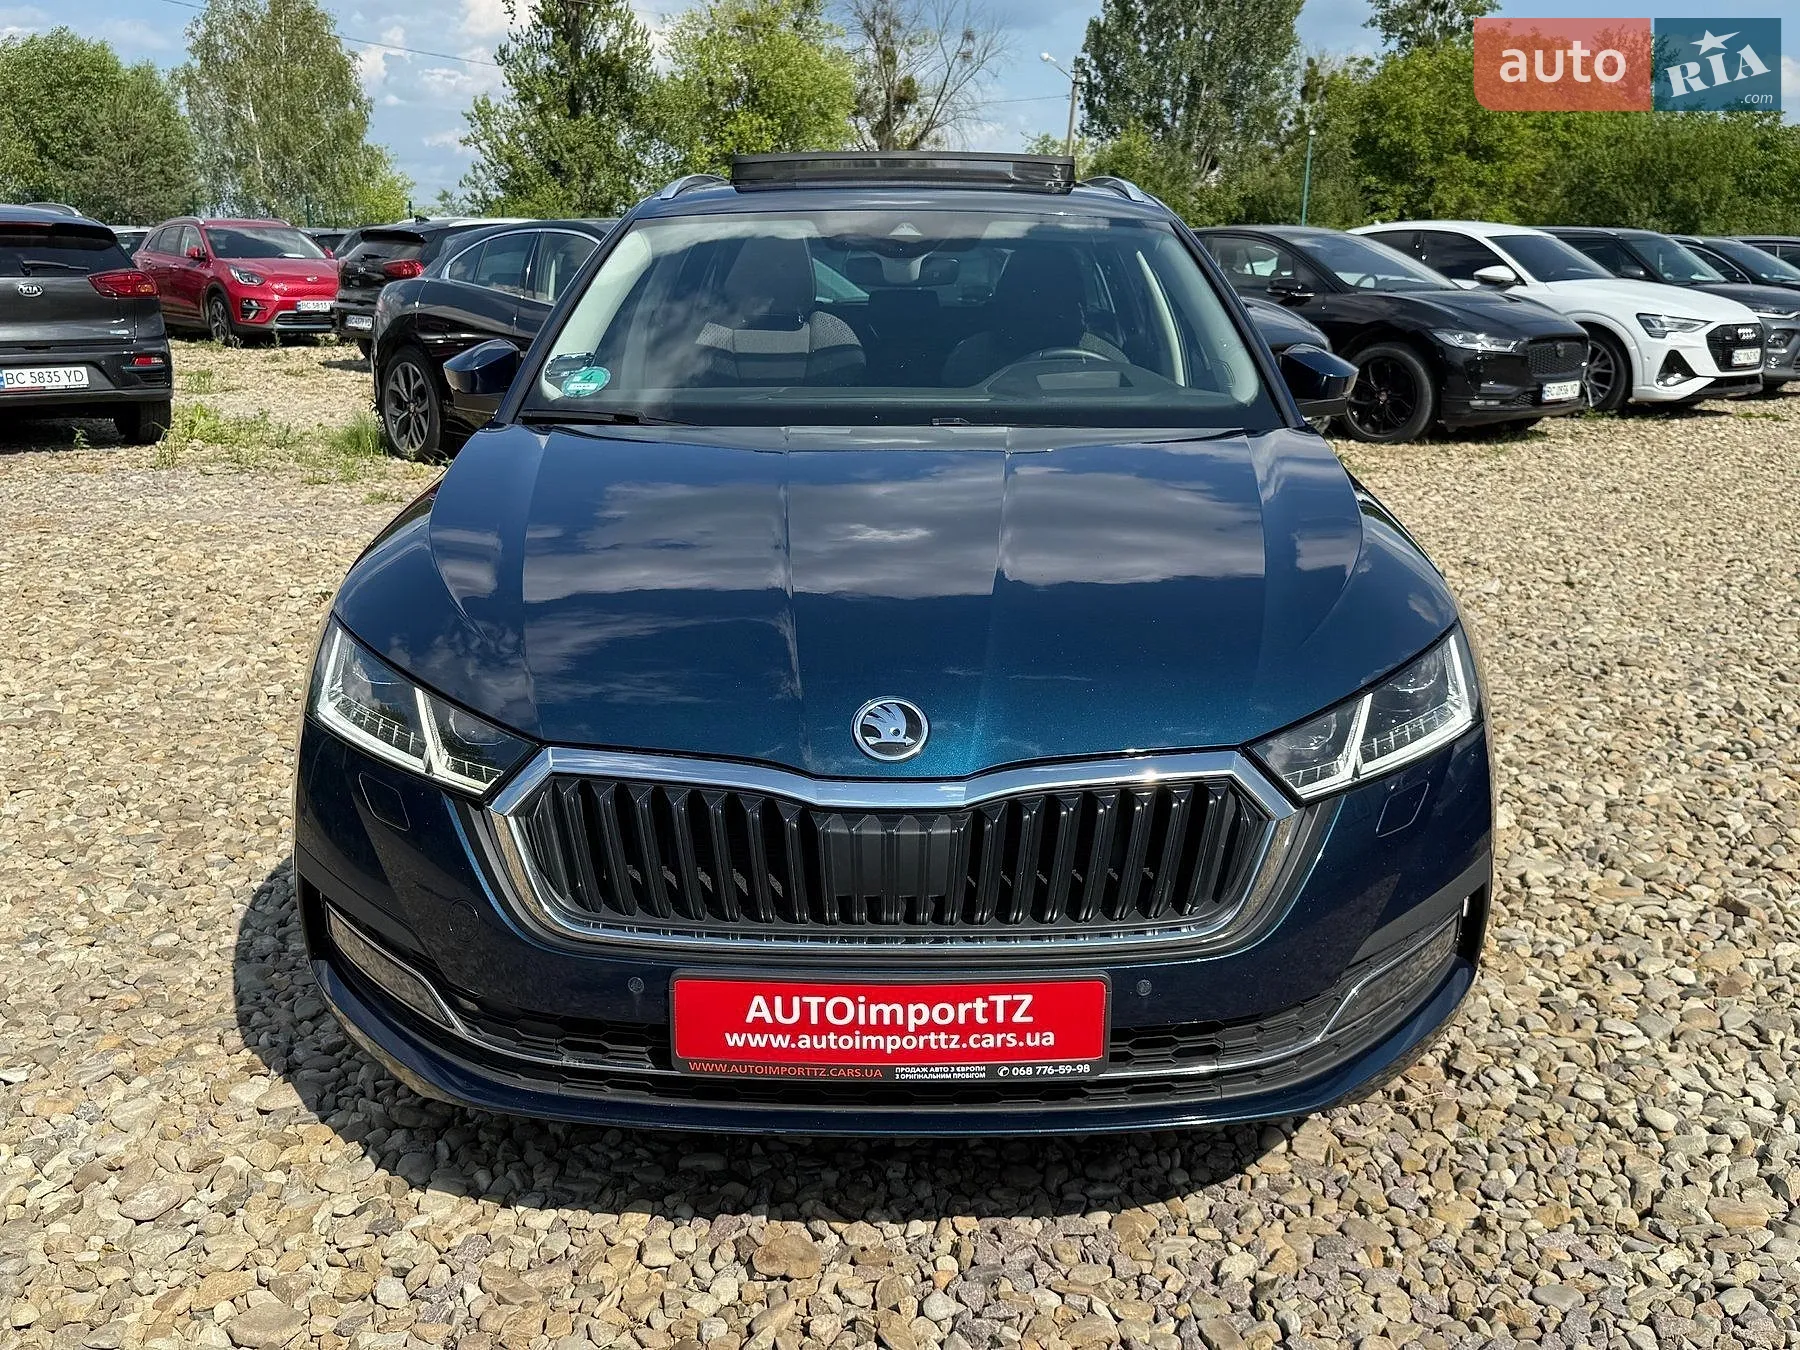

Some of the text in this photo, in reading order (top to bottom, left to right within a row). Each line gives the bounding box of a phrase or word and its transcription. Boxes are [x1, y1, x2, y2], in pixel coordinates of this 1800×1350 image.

[5, 369, 84, 385] BC 5835 YD
[581, 371, 594, 383] 4
[745, 994, 1034, 1031] AUTOimportTZ
[725, 1030, 1056, 1052] www.autoimporttz.cars.ua
[688, 1061, 884, 1078] WWW.AUTOIMPORTTZ.CARS.UA
[895, 1066, 931, 1074] ПРОДАЖ
[1011, 1064, 1091, 1076] 068 776-59-98
